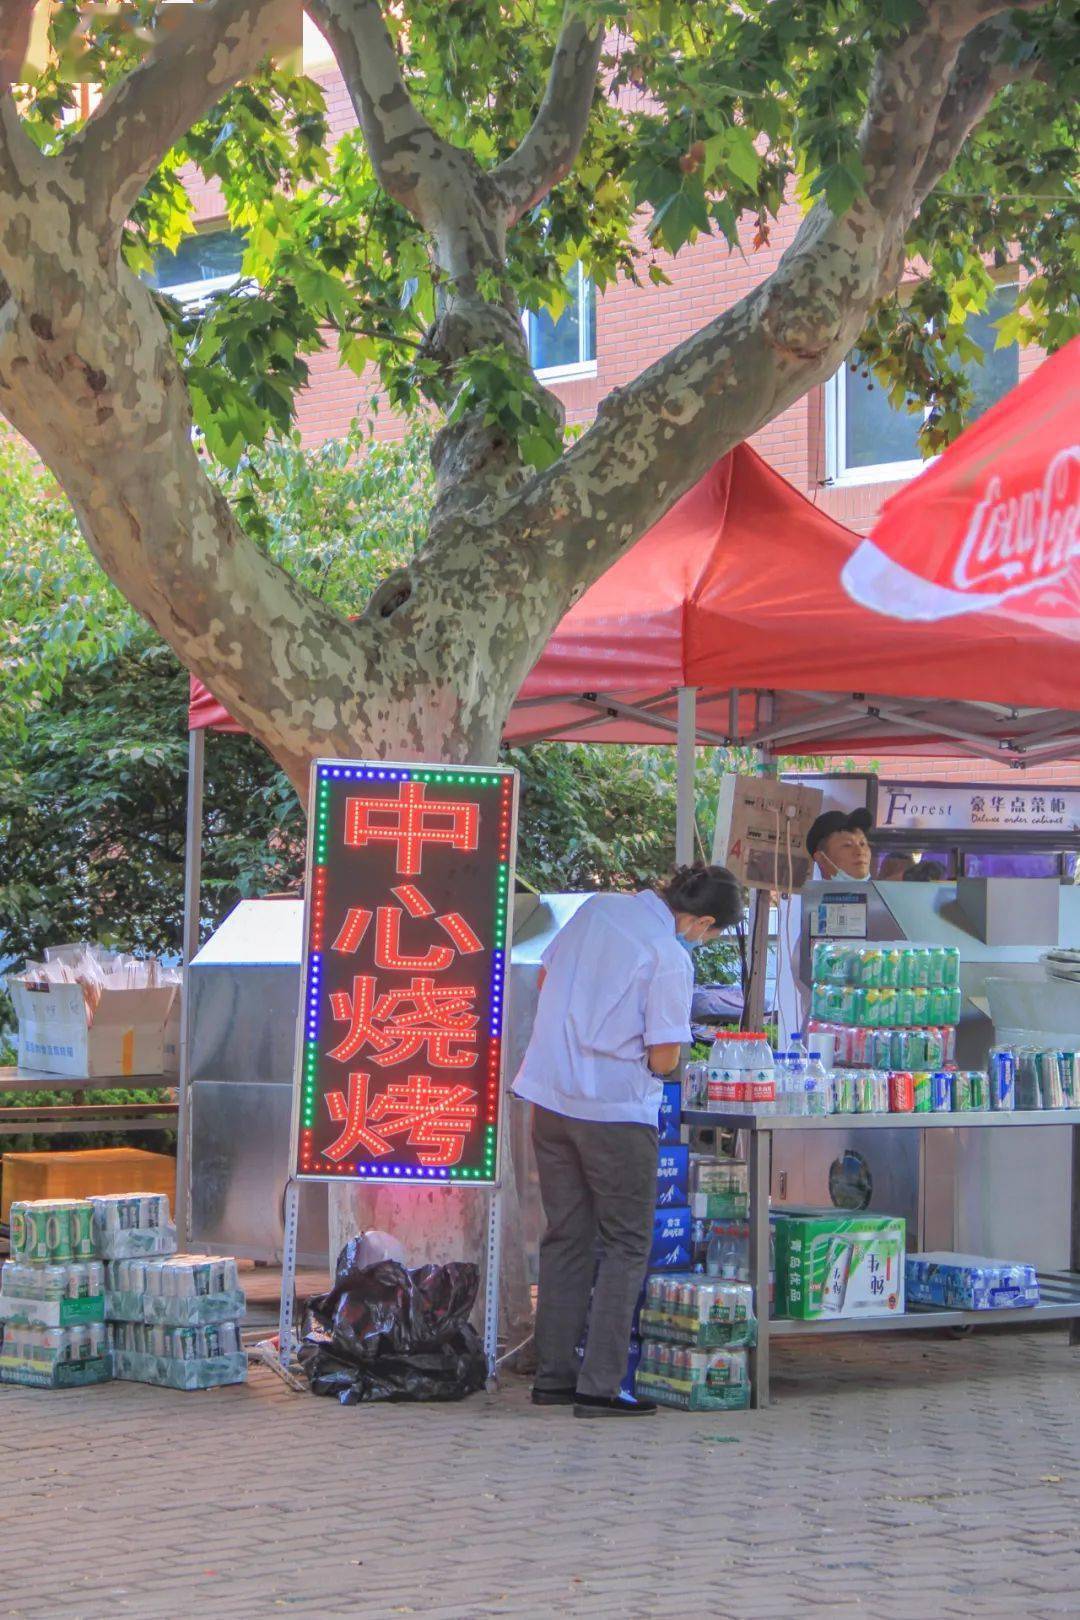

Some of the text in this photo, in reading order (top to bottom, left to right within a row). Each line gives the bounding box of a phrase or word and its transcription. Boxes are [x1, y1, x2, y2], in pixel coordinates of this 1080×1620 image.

[883, 793, 952, 825] Forest
[969, 796, 1066, 814] 豪华点菜柜
[1004, 815, 1028, 825] order
[321, 781, 485, 1167] 中心烧烤
